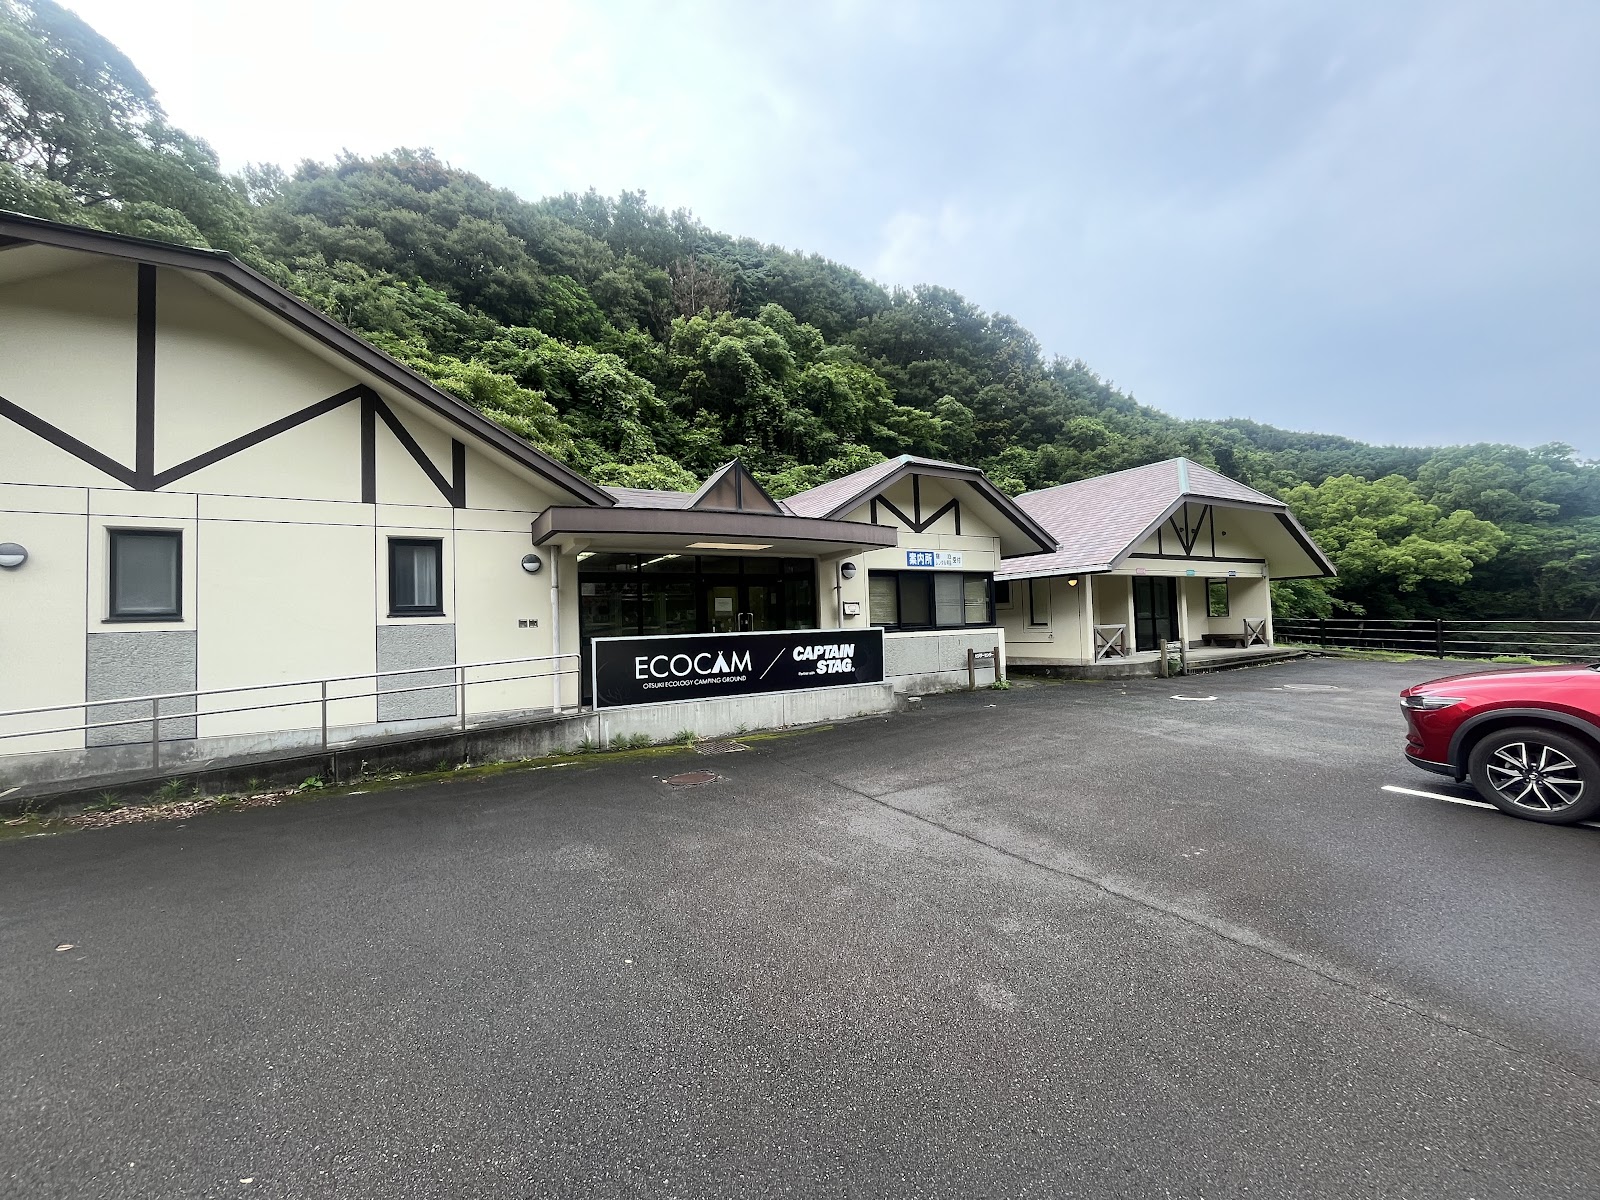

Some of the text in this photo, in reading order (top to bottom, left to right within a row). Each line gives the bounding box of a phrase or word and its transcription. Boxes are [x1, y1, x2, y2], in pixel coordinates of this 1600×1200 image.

[909, 552, 932, 565] 案内所
[793, 644, 855, 661] CAPTAIN
[635, 650, 752, 679] ECOCAM
[643, 675, 746, 689] OTSUKI ECOLOGY CAMPING GROUND
